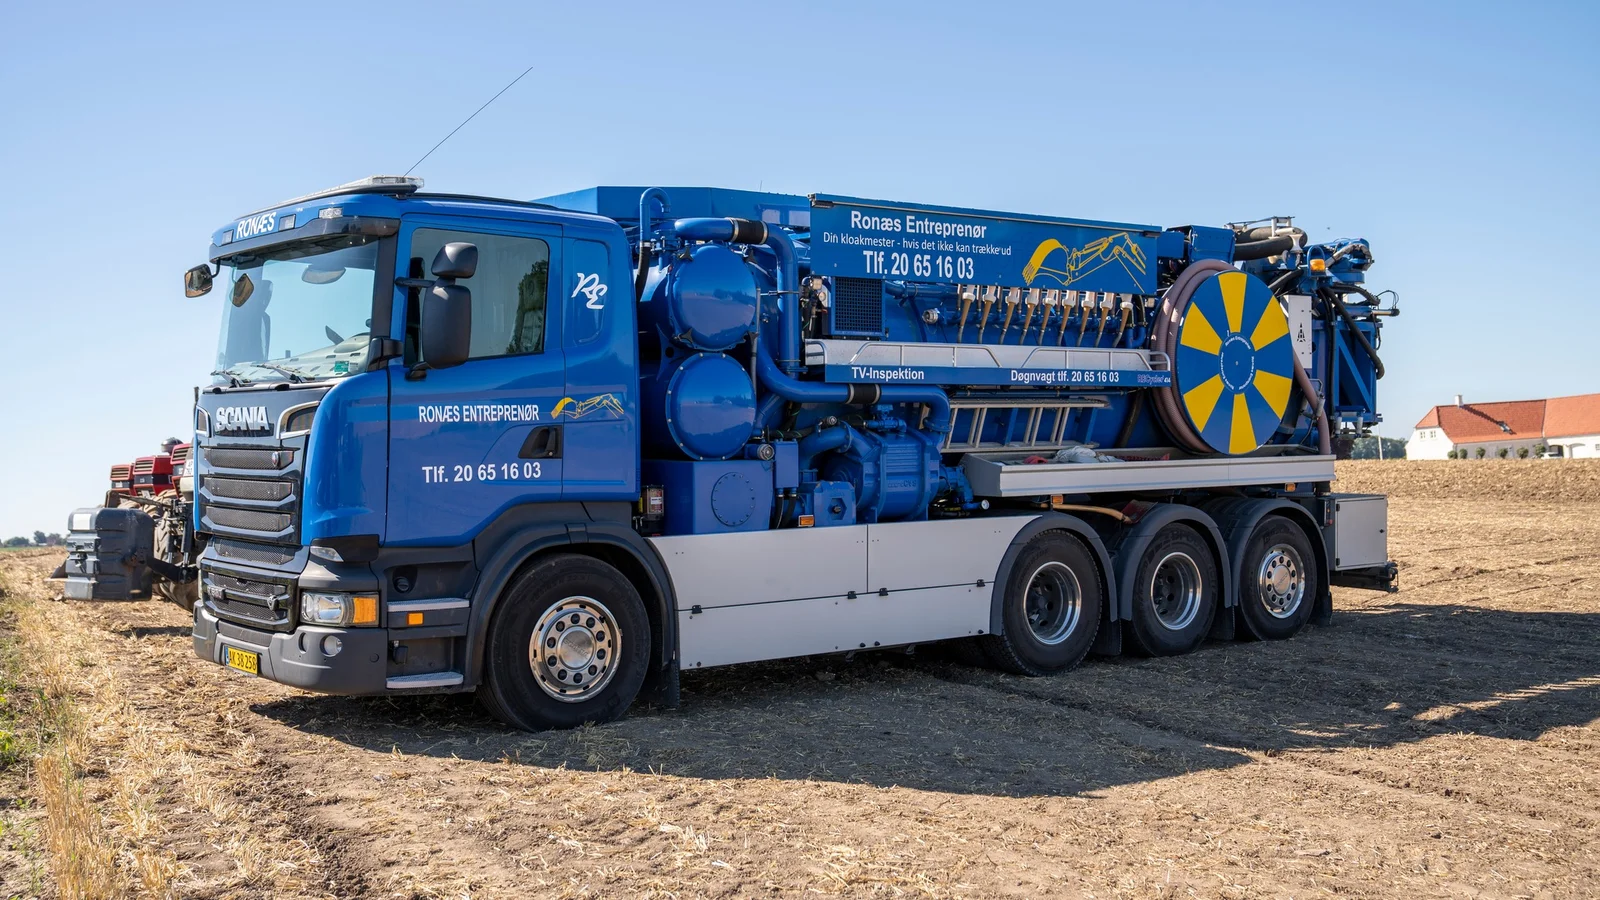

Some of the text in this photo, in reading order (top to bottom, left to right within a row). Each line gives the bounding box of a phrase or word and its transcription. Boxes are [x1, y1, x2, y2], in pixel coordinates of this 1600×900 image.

[236, 211, 277, 239] RONÆS
[851, 210, 987, 238] Ronæs Entreprenør
[823, 231, 839, 243] Din
[841, 233, 895, 248] kloakmester
[902, 237, 920, 250] hvis
[921, 239, 936, 250] det
[937, 241, 954, 252] ikke
[955, 242, 970, 253] kan
[972, 244, 999, 255] trække
[1001, 245, 1012, 256] ud
[863, 250, 974, 280] Tlf. 20 65 16 03
[852, 366, 925, 383] TV-Inspektion
[1010, 369, 1119, 384] Døgnvagt tlf. 20 65 16 03
[215, 406, 270, 431] SCANIA
[418, 404, 540, 423] RONÆS ENTREPRENØR
[422, 461, 542, 484] Tlf. 20 65 16 03
